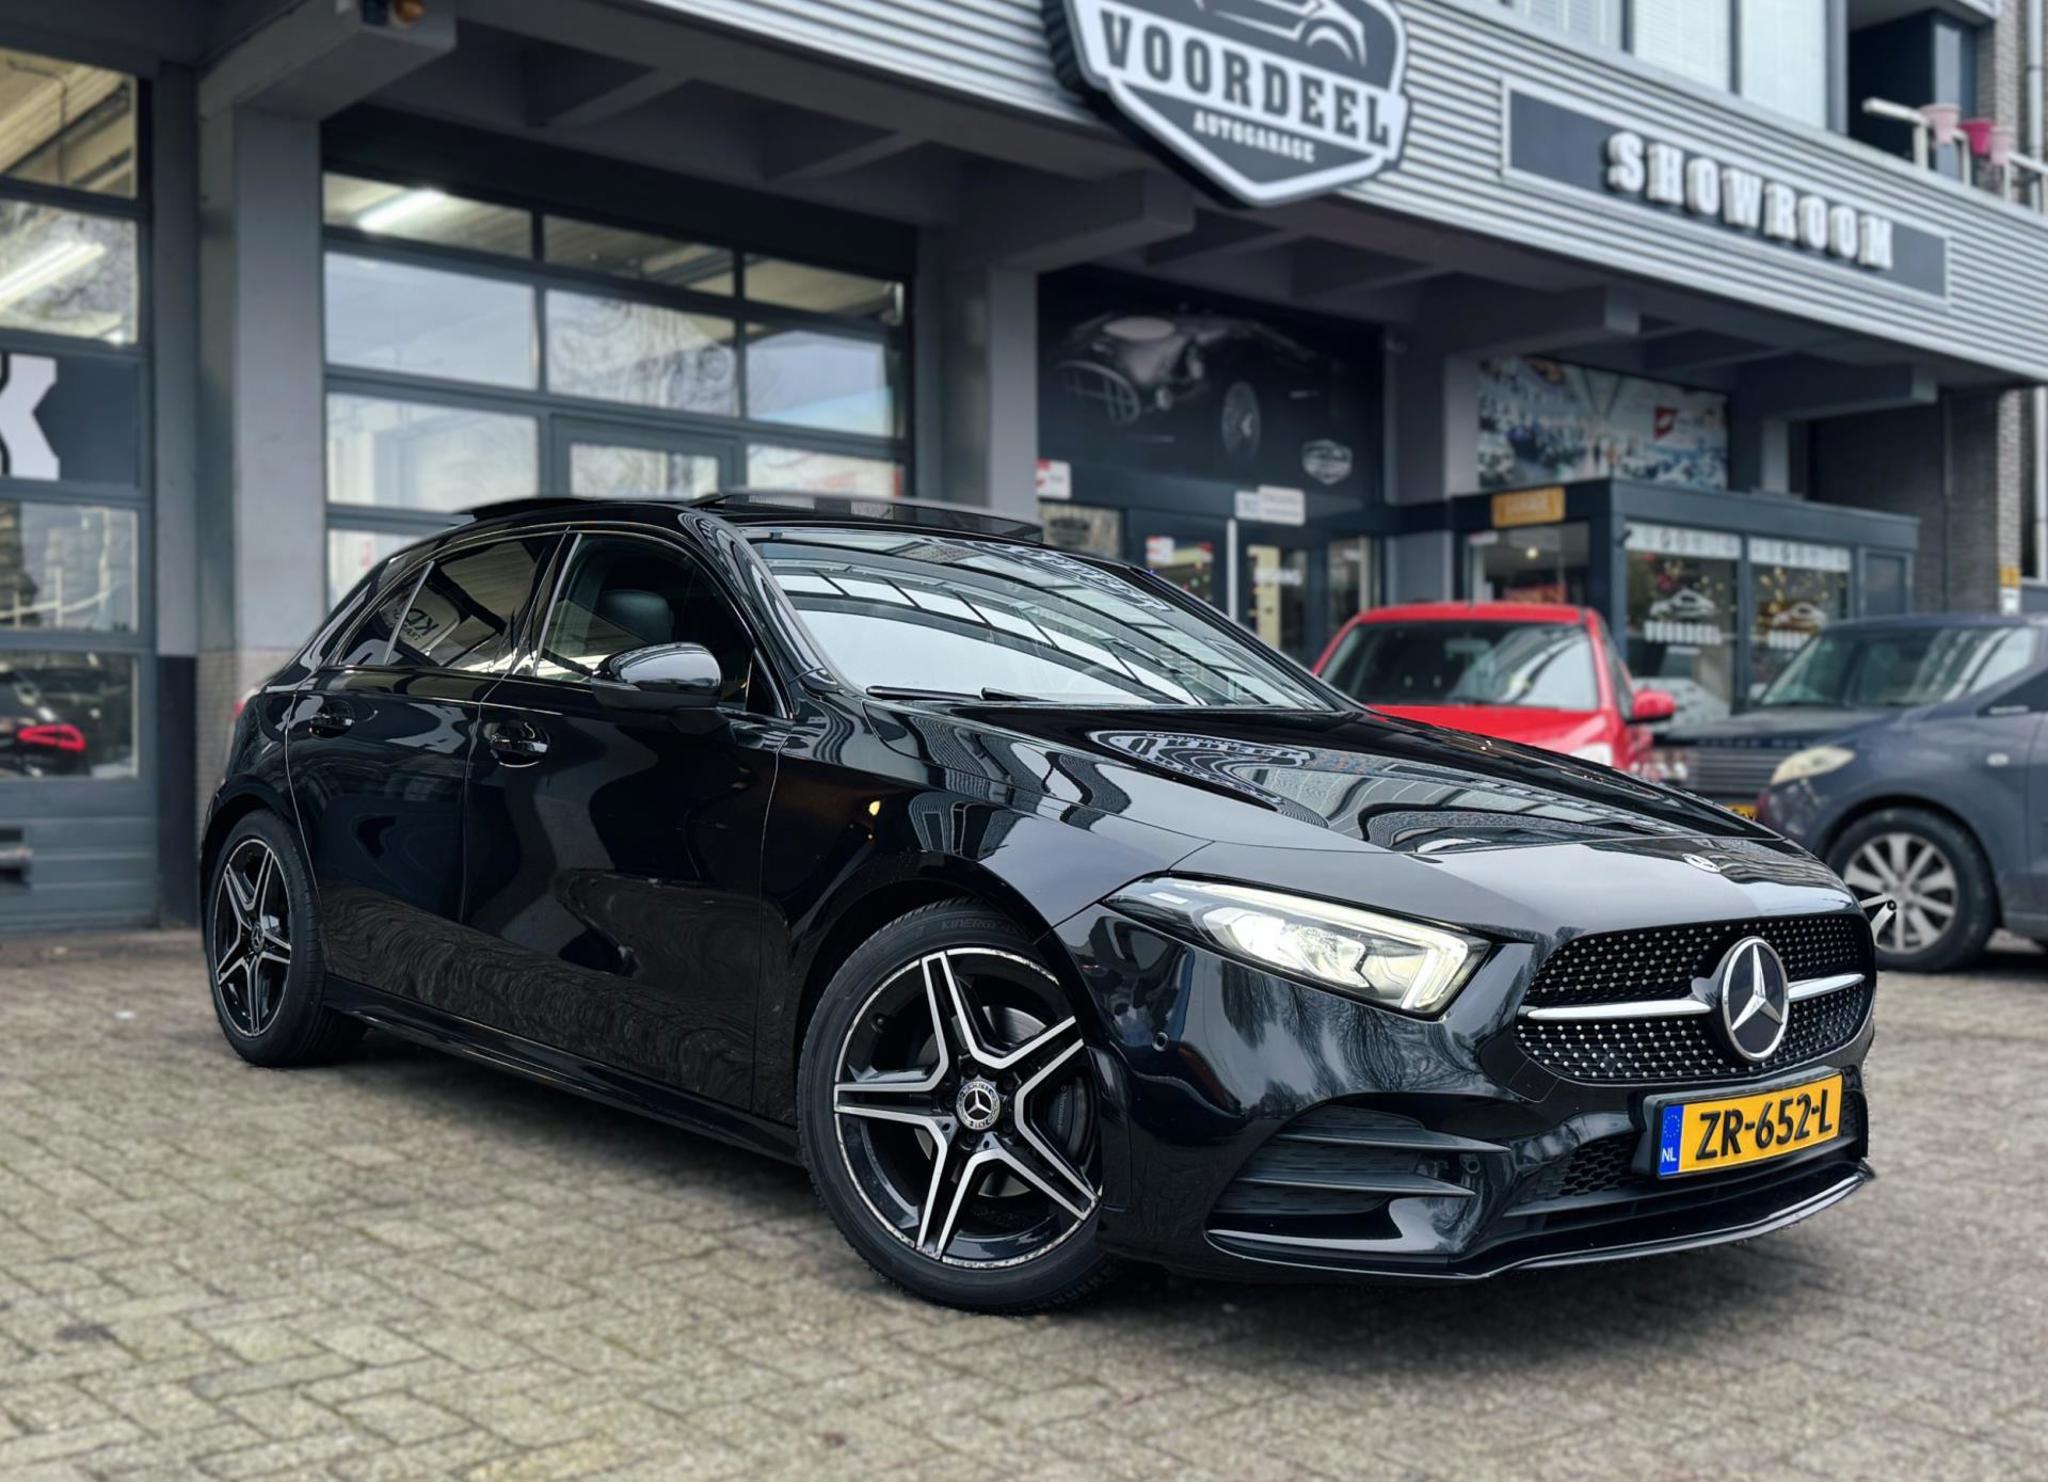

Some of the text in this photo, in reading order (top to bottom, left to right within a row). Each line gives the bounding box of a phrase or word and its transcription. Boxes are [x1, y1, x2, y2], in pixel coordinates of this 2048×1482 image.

[1101, 9, 1390, 149] VOORDEEL
[1194, 109, 1315, 164] AUTOGARAGE
[1607, 131, 1894, 271] SHOWROOM
[1660, 1147, 1678, 1163] NL
[1695, 1088, 1833, 1160] ZR-652-L
